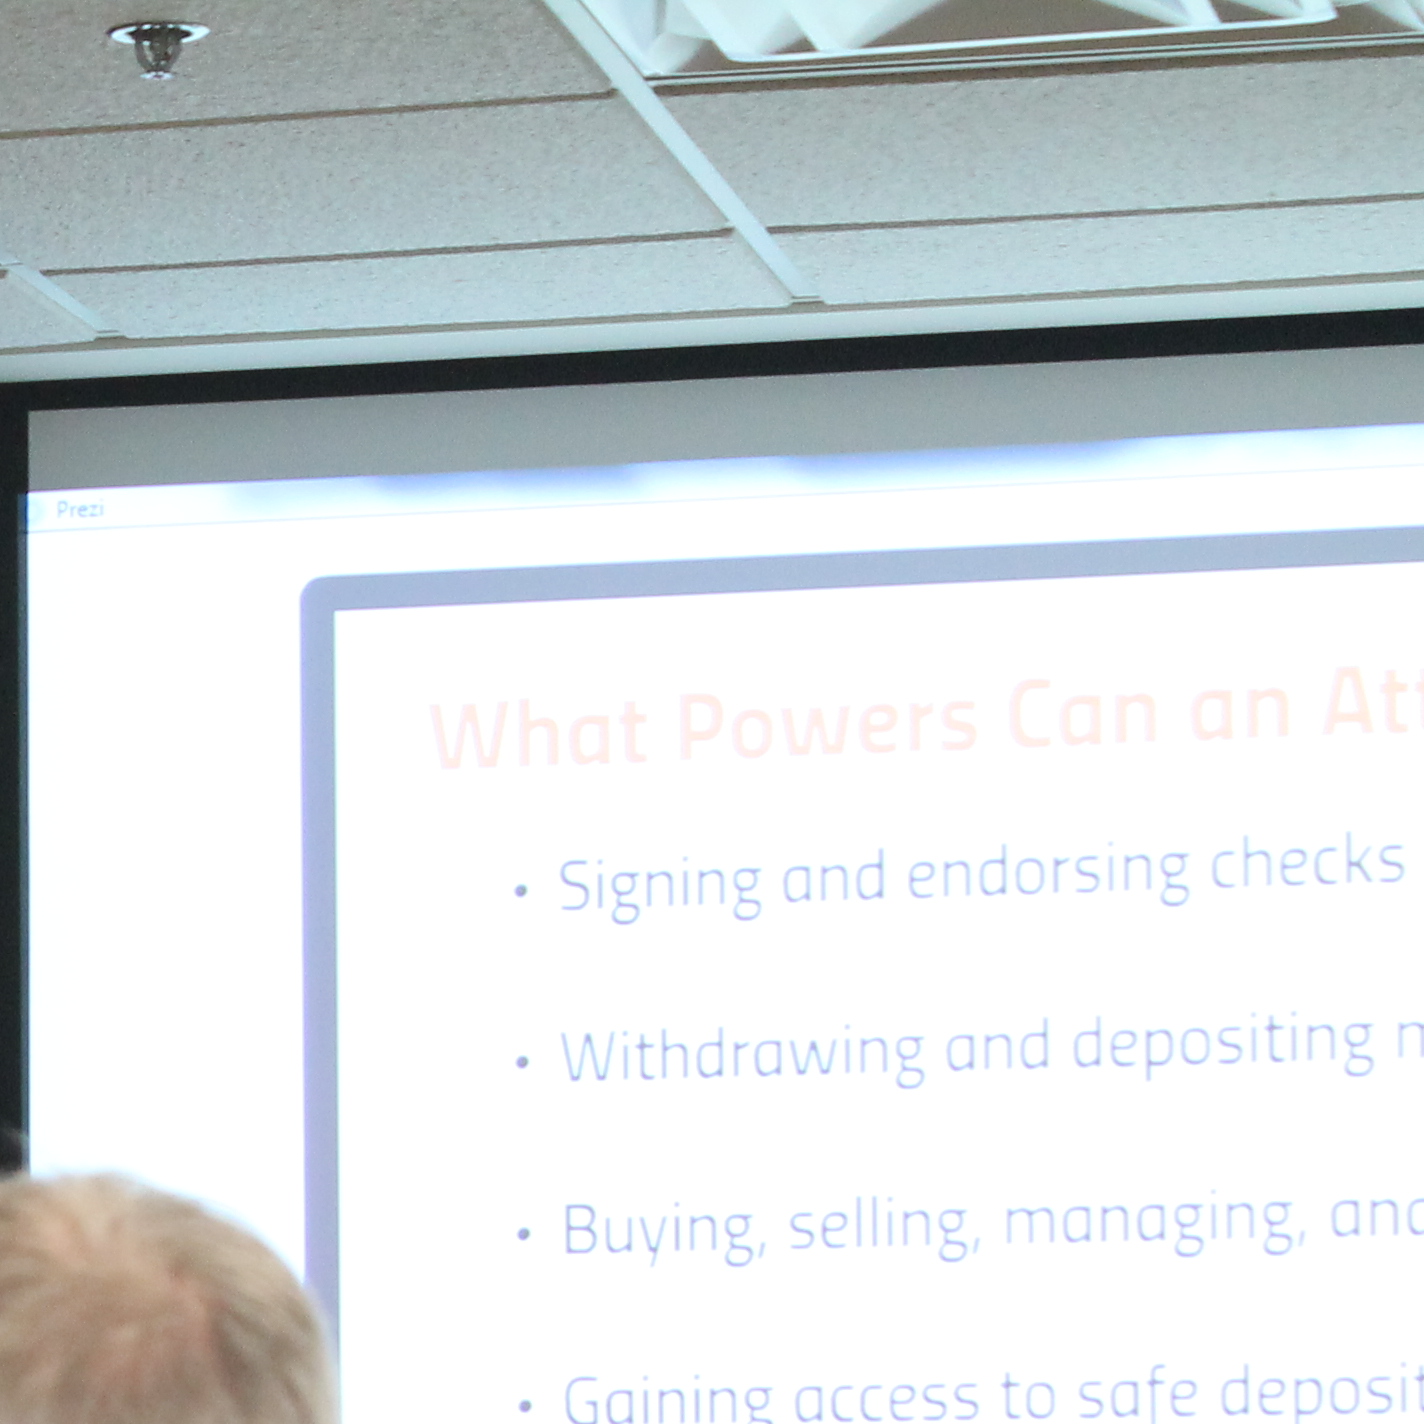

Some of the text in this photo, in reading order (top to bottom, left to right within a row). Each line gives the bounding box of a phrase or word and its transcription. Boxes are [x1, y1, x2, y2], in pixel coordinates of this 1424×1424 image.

[56, 498, 106, 519] Prezi
[428, 698, 648, 770] What
[679, 692, 979, 762] Powers
[1008, 678, 1158, 748] Can
[1189, 676, 1290, 743] an
[558, 831, 1407, 925] Signing and endorsing checks
[559, 1023, 927, 1091] Withdrawing
[945, 1017, 1051, 1074] and
[1072, 1010, 1376, 1083] depositing
[563, 1202, 768, 1269] Buying,
[788, 1195, 982, 1265] selling,
[1005, 1189, 1307, 1260] managing,
[793, 1377, 981, 1424] access
[999, 1371, 1057, 1421] to
